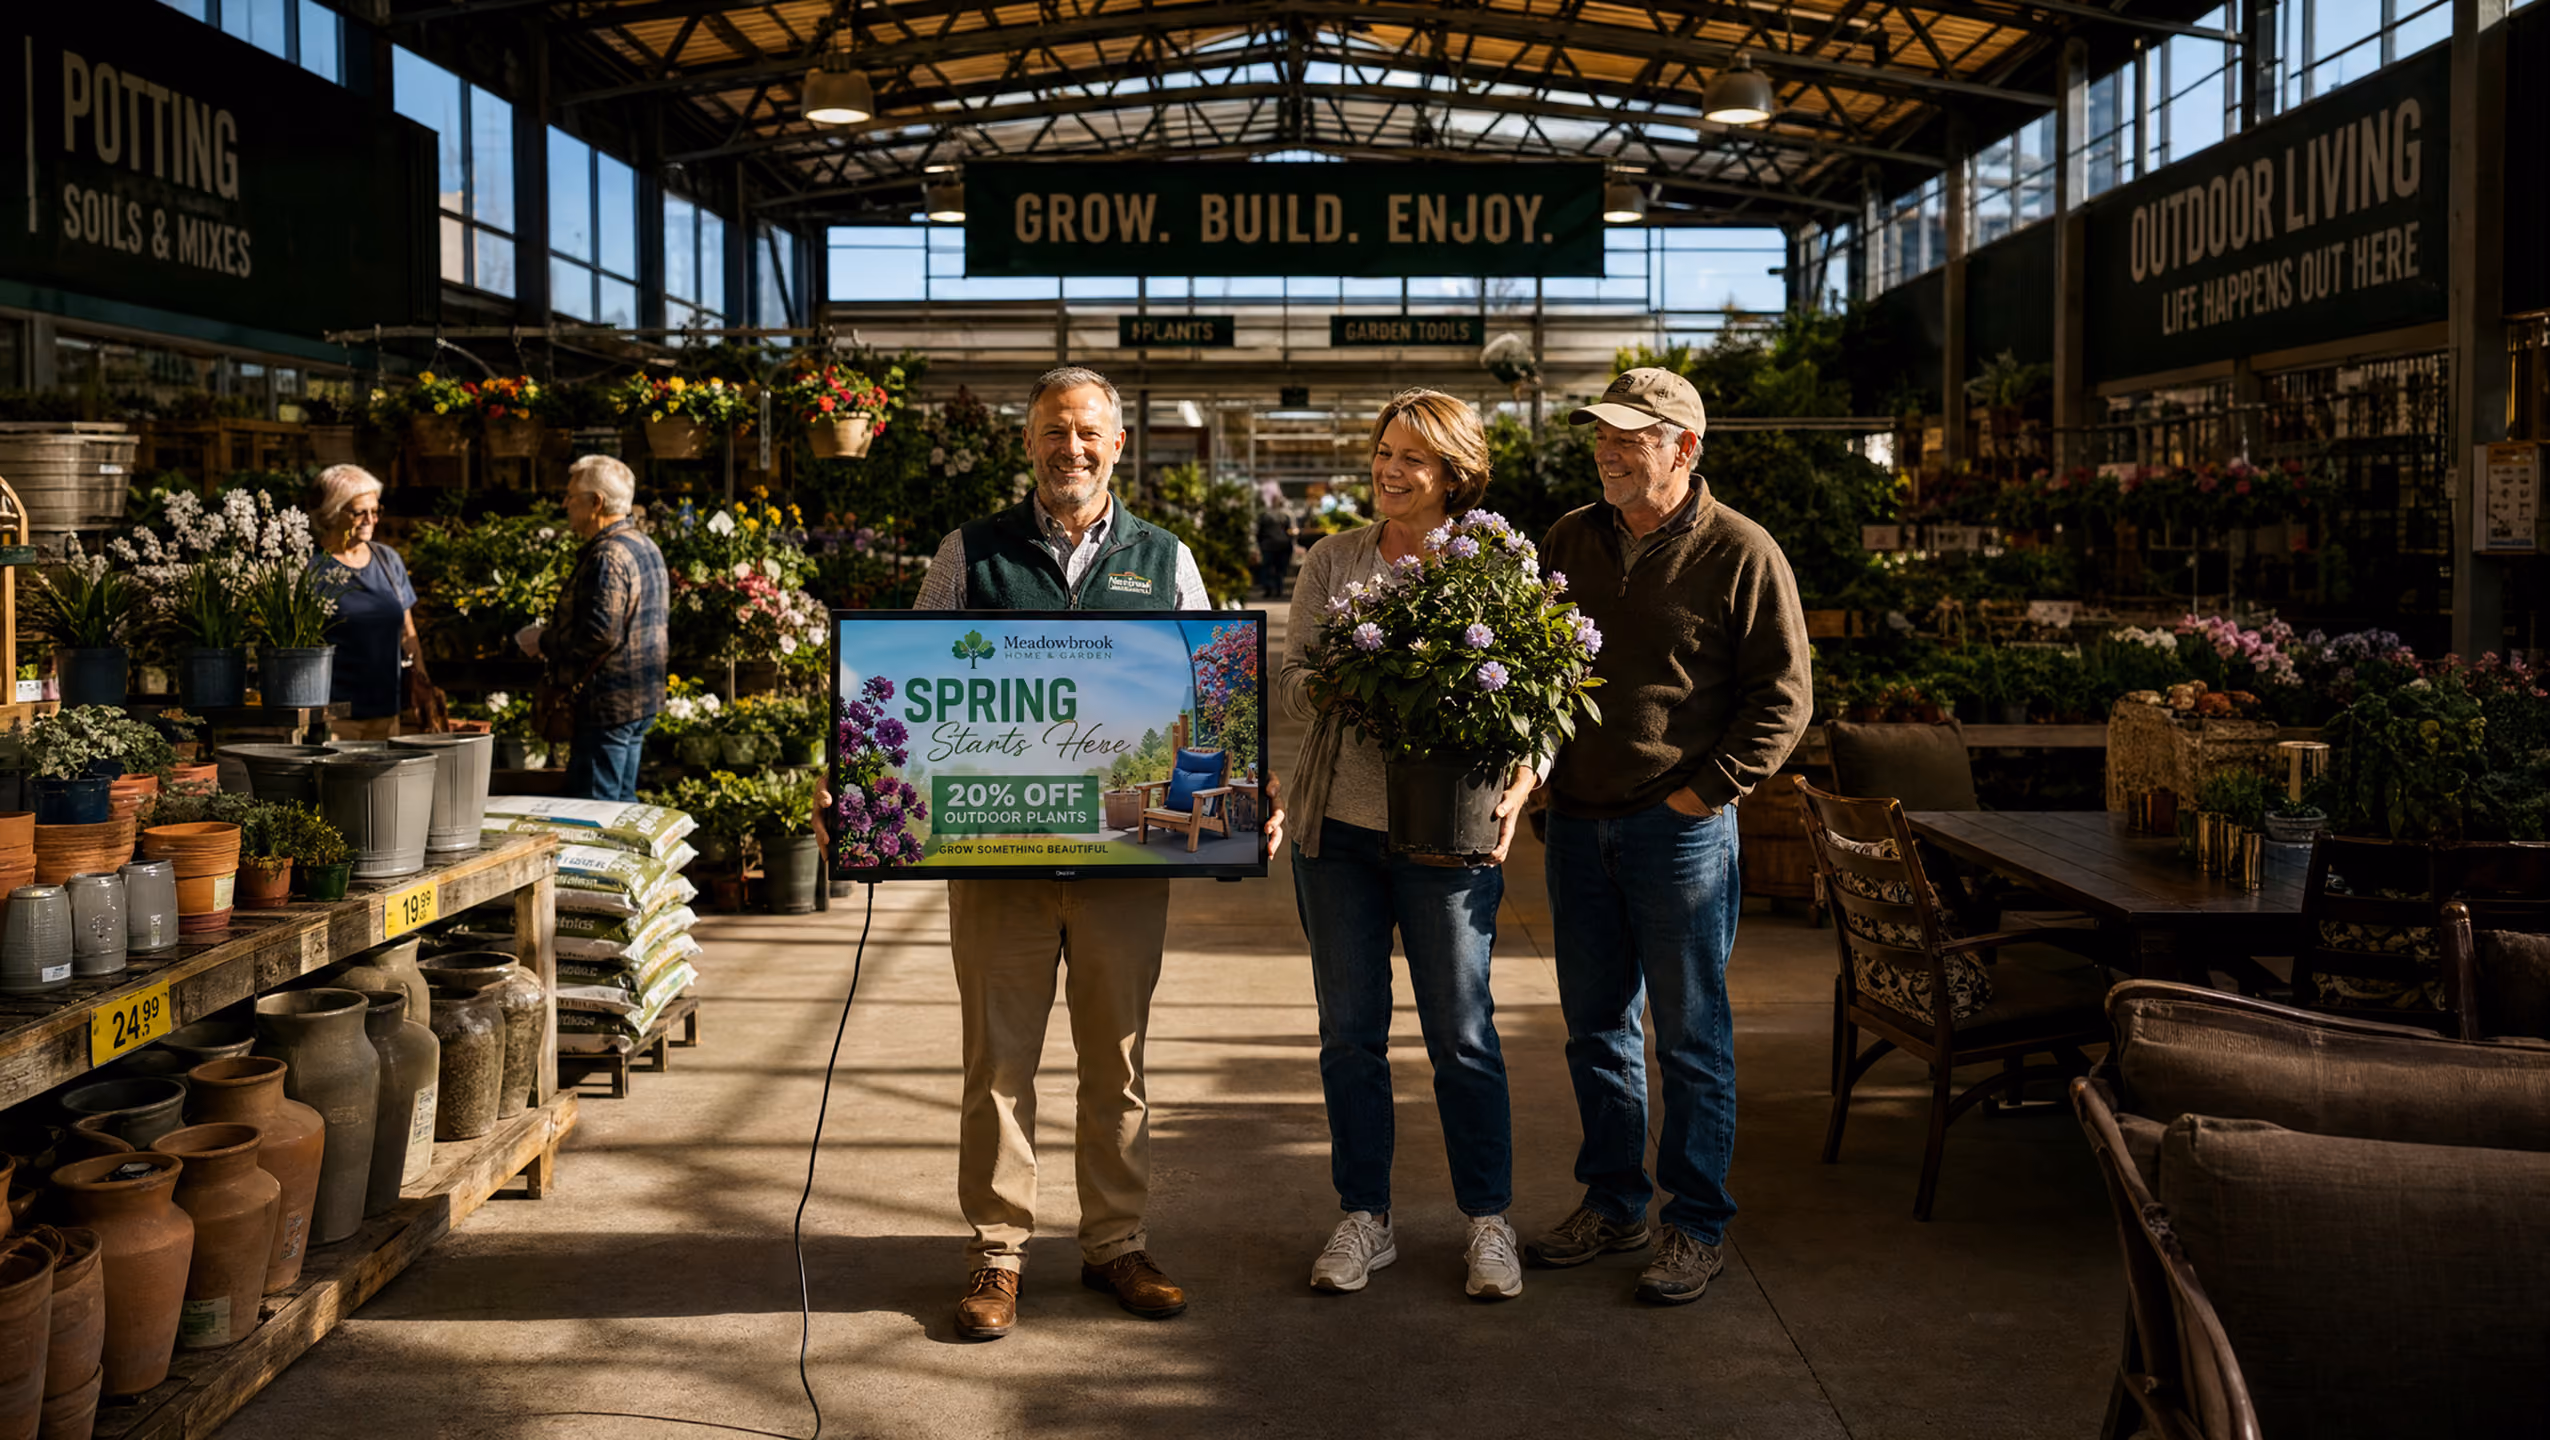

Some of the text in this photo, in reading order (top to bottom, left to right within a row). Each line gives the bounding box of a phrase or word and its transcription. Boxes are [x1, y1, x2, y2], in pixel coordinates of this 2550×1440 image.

[62, 48, 240, 202] POTTING
[2129, 97, 2423, 284] OUTDOOR LIVING
[63, 182, 253, 279] SOILS & MIXES
[1014, 192, 1555, 244] GROW. BUILD. ENJOY.
[2162, 219, 2421, 336] LIFE HAPPENS OUT HERE
[1344, 320, 1472, 342] GARDEN TOOLS
[1003, 634, 1114, 650] Meadowbrook
[1004, 651, 1113, 660] HOME & GARDEN
[904, 677, 1077, 723] SPRING
[927, 718, 1132, 762] Starts Here
[947, 782, 1085, 808] 20% OFF
[944, 811, 1087, 824] OUTDOOR PLANTS
[938, 844, 1109, 855] GROW SOMETHING BEAUTIFUL
